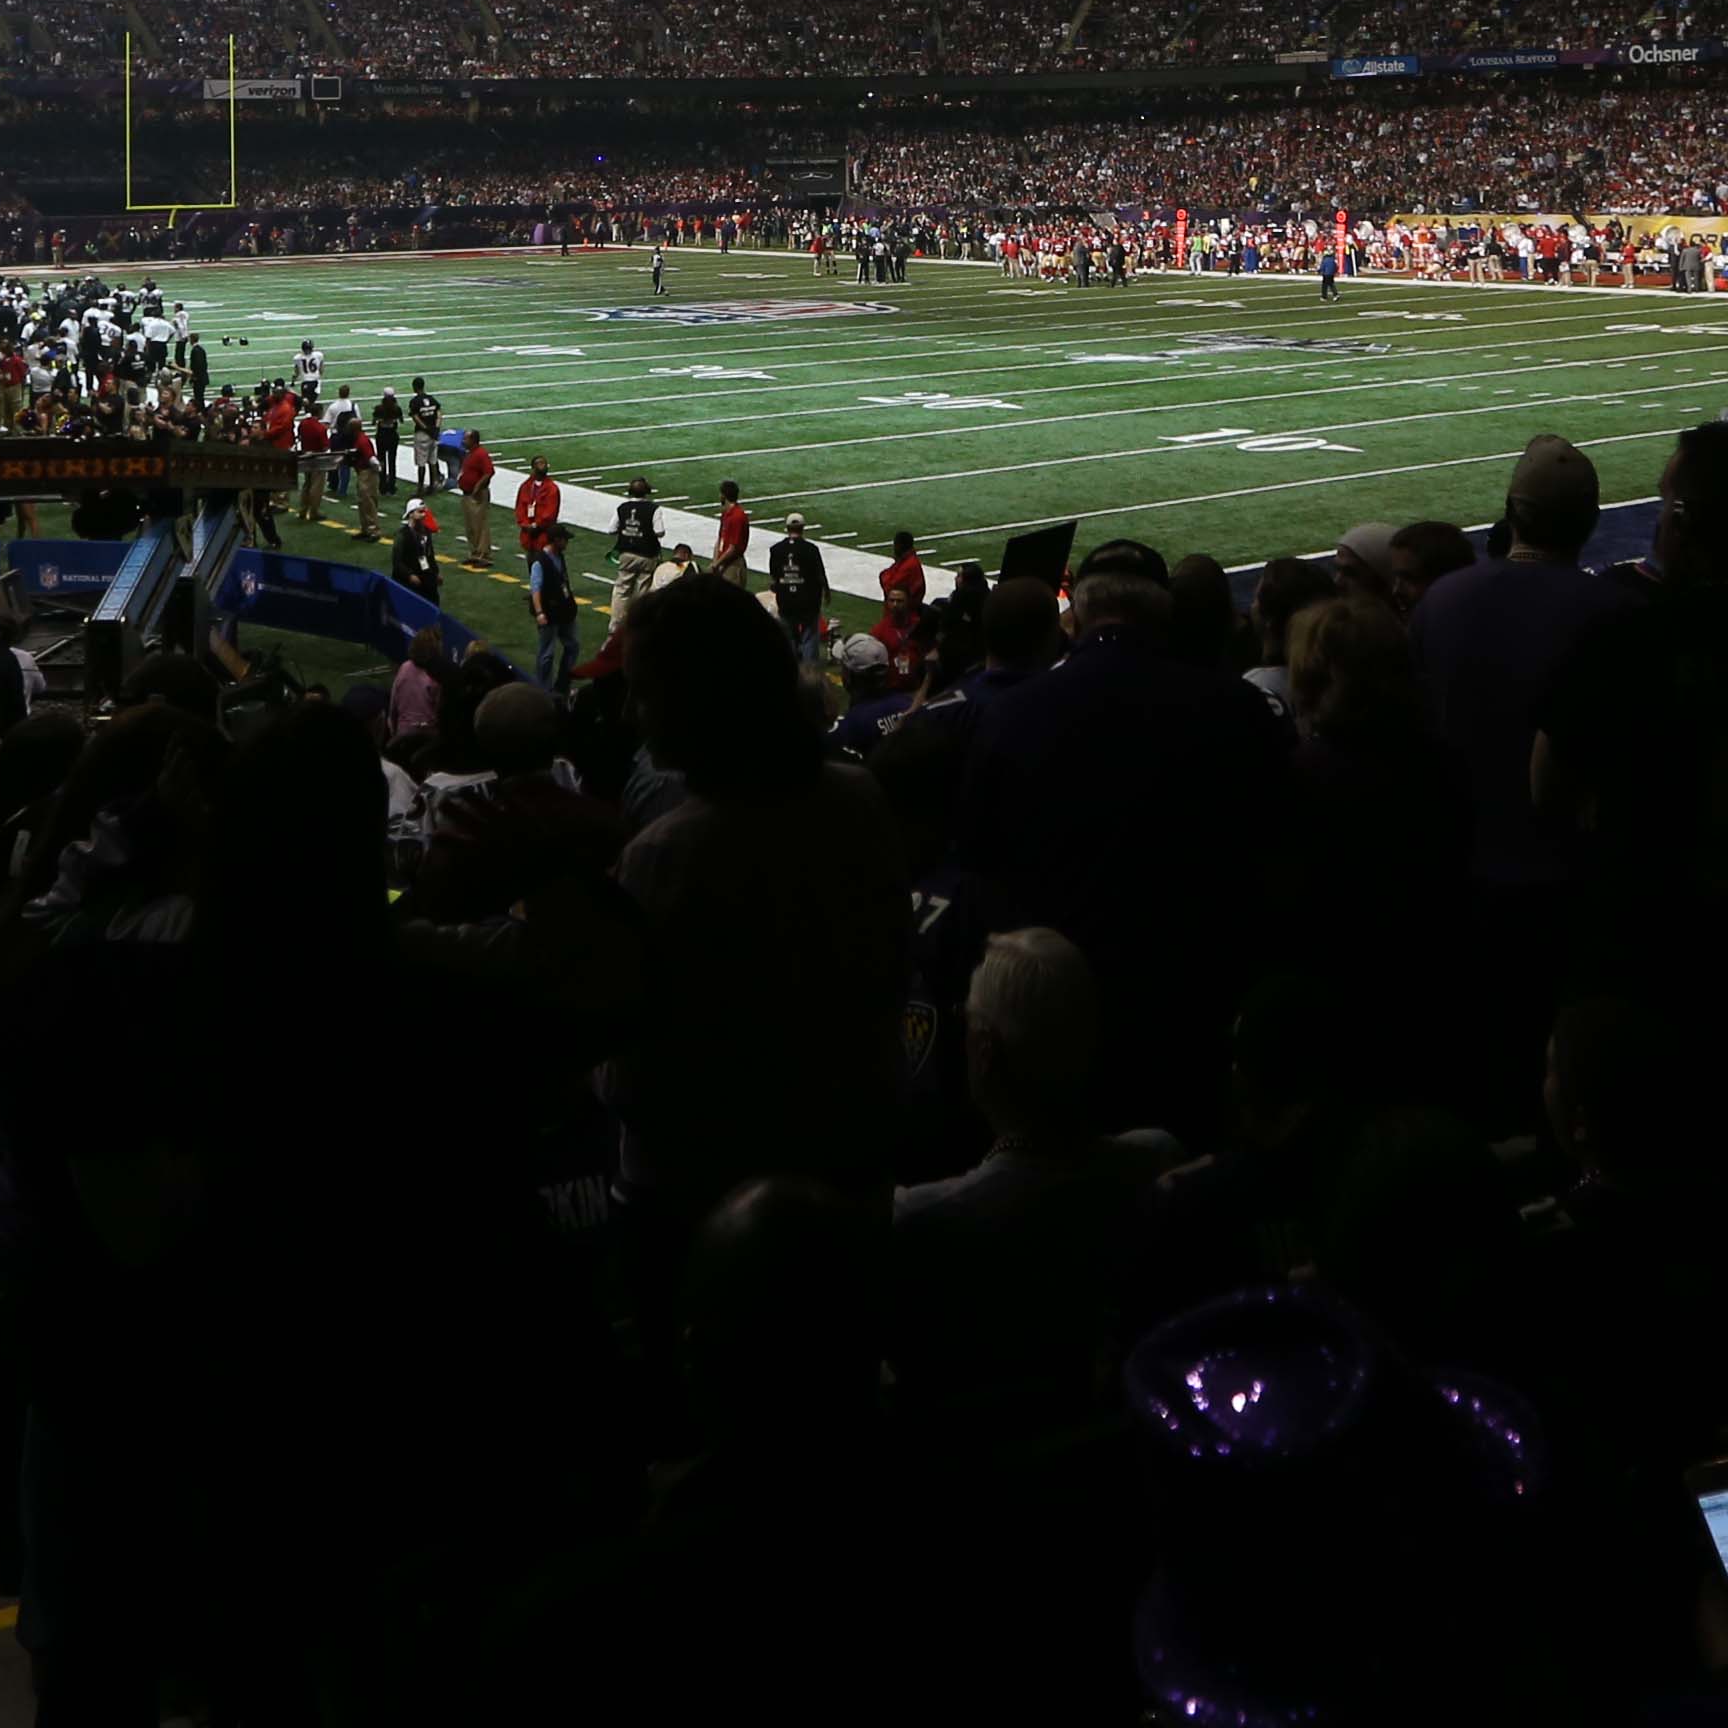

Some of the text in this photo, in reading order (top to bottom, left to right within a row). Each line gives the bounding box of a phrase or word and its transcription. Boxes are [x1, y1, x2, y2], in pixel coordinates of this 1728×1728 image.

[1471, 56, 1514, 66] LOUISIANA
[1629, 43, 1699, 65] Ochsner
[1362, 59, 1405, 73] Allstate
[247, 85, 296, 99] verizon
[302, 358, 317, 374] 16
[858, 392, 1002, 410] 20
[1157, 427, 1328, 453] 10
